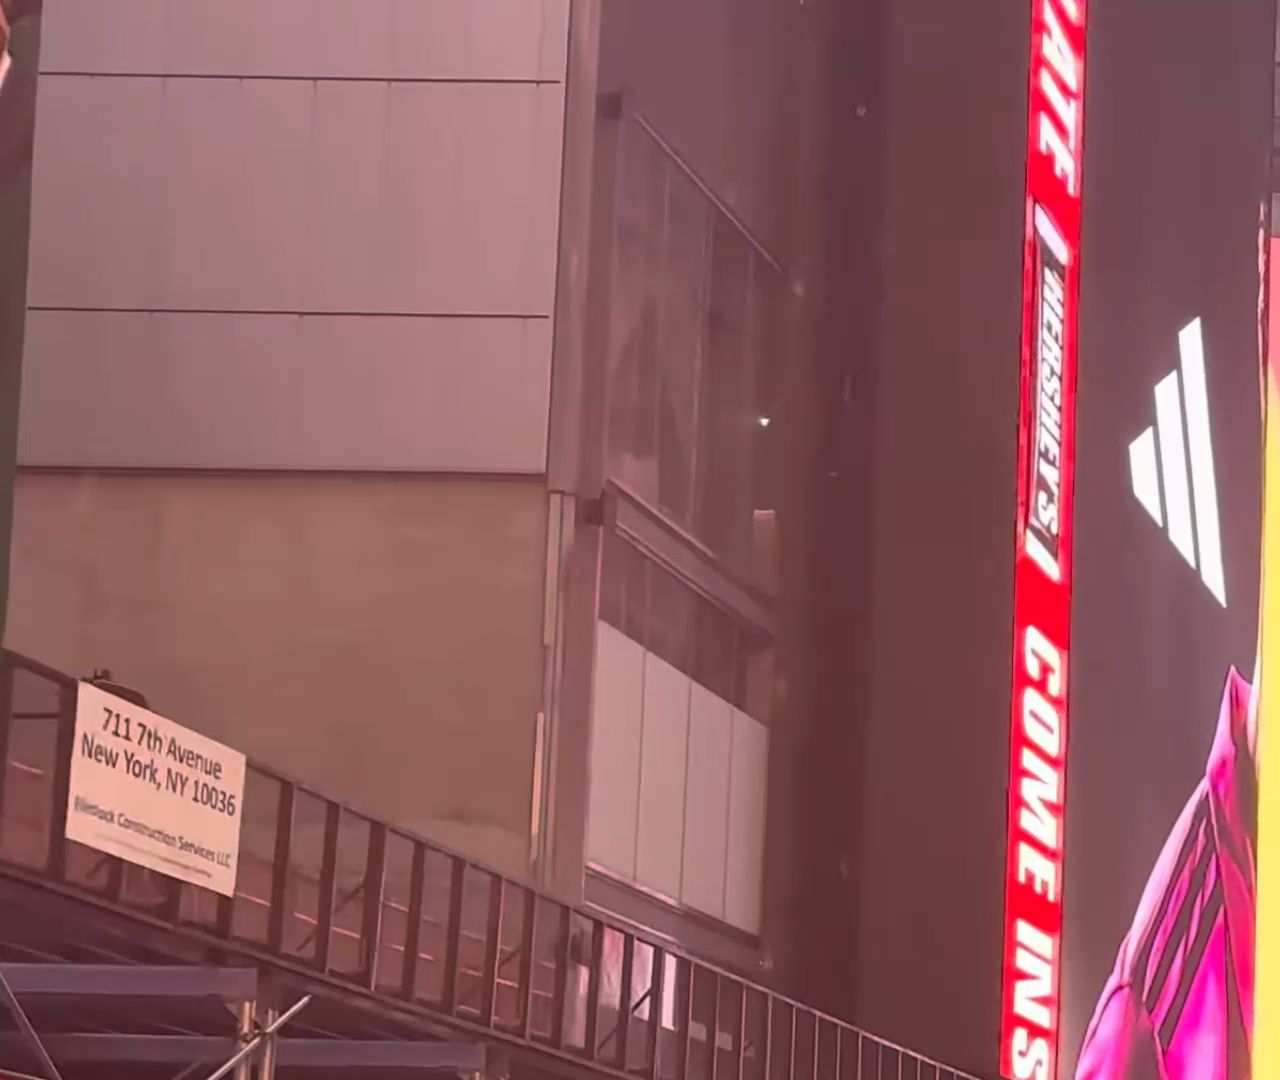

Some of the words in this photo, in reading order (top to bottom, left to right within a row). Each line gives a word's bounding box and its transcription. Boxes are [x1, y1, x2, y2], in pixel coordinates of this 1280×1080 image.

[1039, 0, 1078, 198] ATE
[81, 733, 119, 769] New
[123, 748, 162, 791] York,
[165, 767, 189, 797] NY
[192, 780, 236, 817] 10036
[101, 707, 132, 742] 711
[137, 722, 163, 754] 7th
[166, 736, 222, 780] Avenue
[1017, 624, 1061, 902] COME
[116, 812, 178, 848] Construction
[178, 835, 215, 861] Services
[216, 852, 231, 869] LLC
